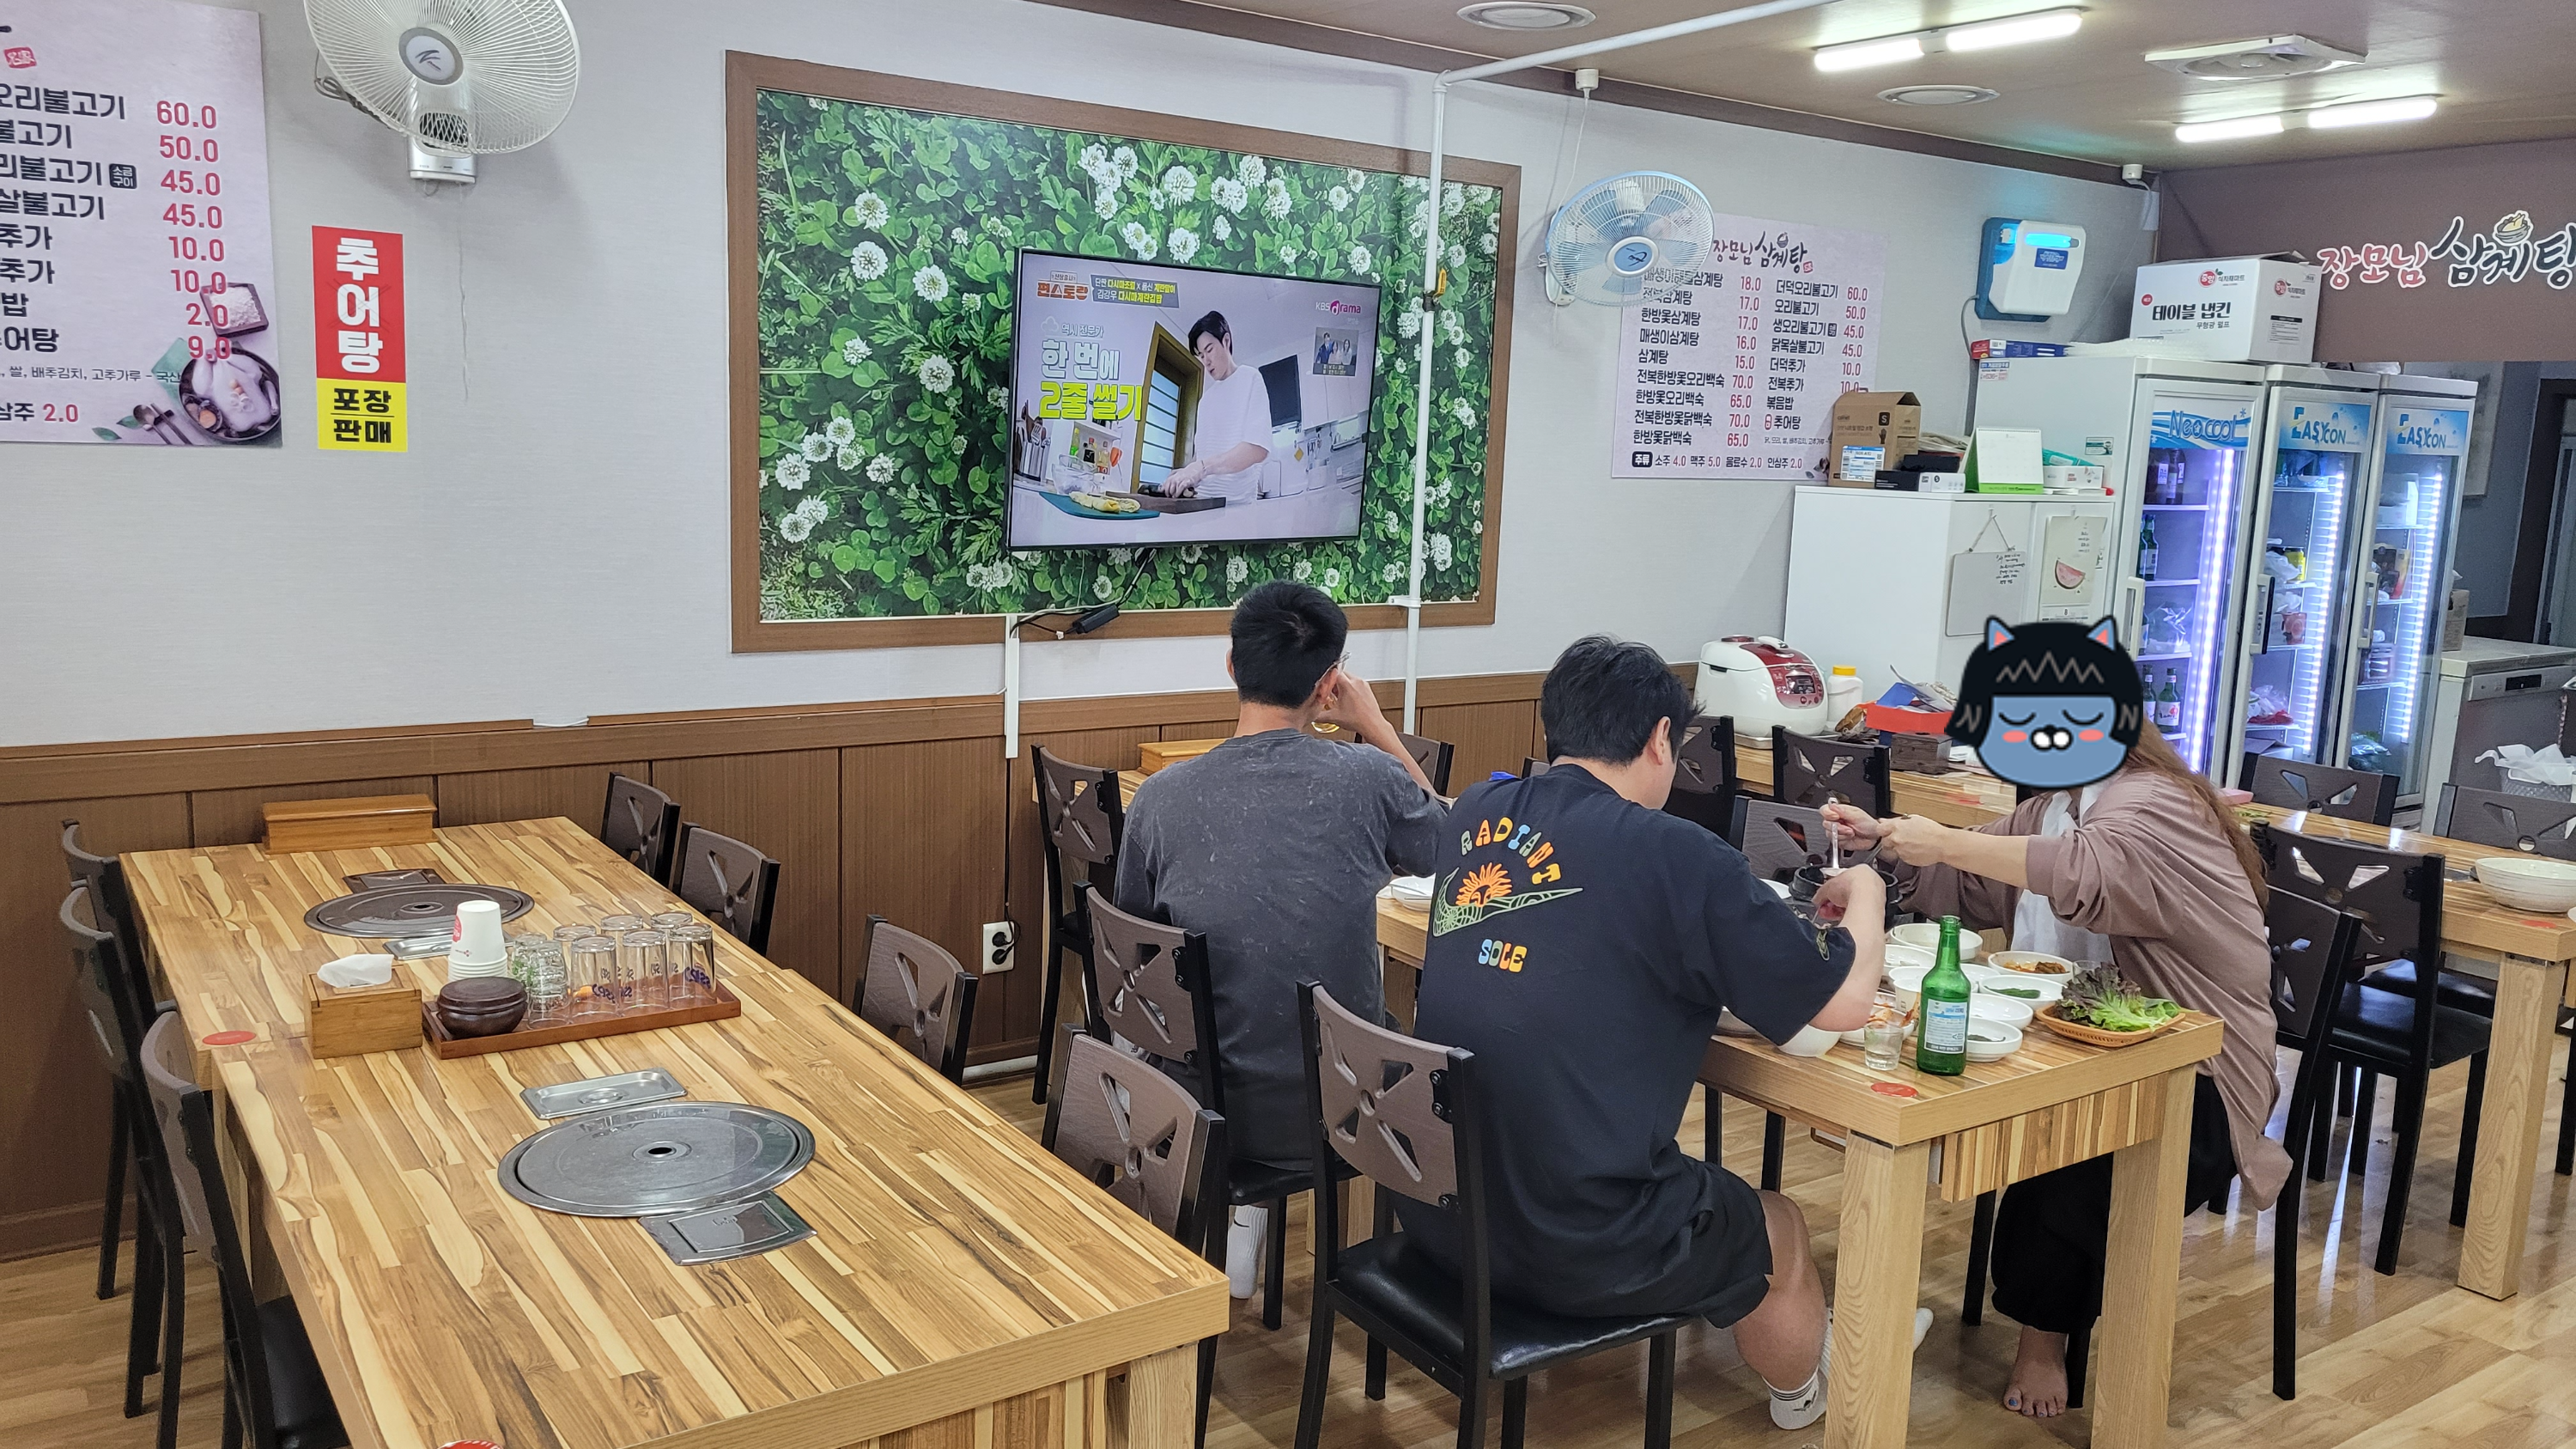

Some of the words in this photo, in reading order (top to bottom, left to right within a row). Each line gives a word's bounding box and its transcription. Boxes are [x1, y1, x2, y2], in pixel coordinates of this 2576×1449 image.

[156, 100, 217, 129] 60.0
[160, 135, 219, 162] 50.0
[112, 166, 133, 177] 소금
[161, 169, 221, 196] 45.0
[113, 176, 134, 187] 구이
[163, 203, 222, 228] 45.0
[0, 223, 52, 250] 추가
[168, 236, 225, 261] 10.0
[1713, 239, 1753, 265] 장모님
[1754, 230, 1807, 273] 삼계탕
[2317, 240, 2428, 290] 장모님
[2428, 216, 2576, 290] 삼계탕
[0, 258, 55, 284] 추가
[171, 270, 227, 295] 10.0
[1741, 276, 1761, 291] 18.0
[1037, 282, 1089, 301] 편스토랑
[1097, 289, 1117, 301] 김강우
[1776, 279, 1838, 298] 더덕오리불고기
[1847, 286, 1868, 301] 60.0
[3, 293, 29, 318] 밥
[186, 303, 228, 327] 2.0
[336, 237, 383, 374] 추어탕
[1315, 301, 1330, 311] KBS
[1740, 295, 1759, 311] 17.0
[1774, 299, 1820, 316] 오리불고기
[1845, 306, 1866, 320] 50.0
[2152, 303, 2196, 320] 테이블
[2201, 301, 2231, 320] 냅킨
[1641, 307, 1701, 326] 한방옻삼계탕
[1738, 315, 1759, 331] 17.0
[1772, 318, 1826, 336] 생오리불고기
[1844, 325, 1864, 338] 45.0
[1061, 324, 1078, 337] 역시
[1080, 324, 1104, 338] 전문가
[1639, 328, 1699, 347] 매생이삼계탕
[1736, 335, 1757, 350] 16.0
[0, 326, 59, 353] 어탕
[187, 335, 231, 360] 9.0
[1771, 338, 1825, 355] 닭목살불고기
[1842, 344, 1862, 357] 45.0
[1041, 338, 1070, 378] 한
[1074, 341, 1120, 381] 번에
[1638, 348, 1669, 365] 삼계탕
[1735, 355, 1755, 369] 15.0
[1770, 357, 1806, 373] 더덕추가
[1842, 362, 1861, 376] 10.0
[9, 366, 27, 378] 쌀,
[32, 367, 88, 380] 배추김치,
[91, 368, 141, 381] 고추가루
[1637, 368, 1725, 388] 전복한방옻오리백숙
[1732, 374, 1753, 389] 70.0
[1768, 376, 1804, 392] 전복추가
[1840, 381, 1859, 393] 100
[333, 387, 392, 413] 포장
[1039, 381, 1088, 420] 2줄
[1092, 383, 1142, 421] 썰기
[1636, 389, 1704, 406] 한방옻오리백숙
[1730, 393, 1752, 408] 65.0
[1766, 395, 1794, 411] 볶음밥
[43, 404, 78, 422] 2.0
[1634, 409, 1712, 427] 전복한방옻닭백숙
[1728, 413, 1750, 428] 70.0
[1773, 415, 1801, 430] 추어탕
[1881, 415, 1887, 423] S
[333, 419, 392, 443] 판매
[1633, 429, 1692, 446] 한방옻닭백숙
[1727, 433, 1749, 447] 65.0
[1635, 454, 1650, 466] 주류
[1655, 455, 1671, 466] 소주
[1673, 455, 1686, 466] 4.0
[1690, 455, 1705, 467] 맥주
[1708, 456, 1721, 467] 5.0
[1726, 457, 1748, 468] 음료수
[1750, 457, 1762, 468] 2.0
[1767, 457, 1789, 469] 인삼주
[1790, 458, 1802, 469] 2.0
[1461, 817, 1561, 886] RADIANT
[1478, 938, 1528, 972] SOLE
